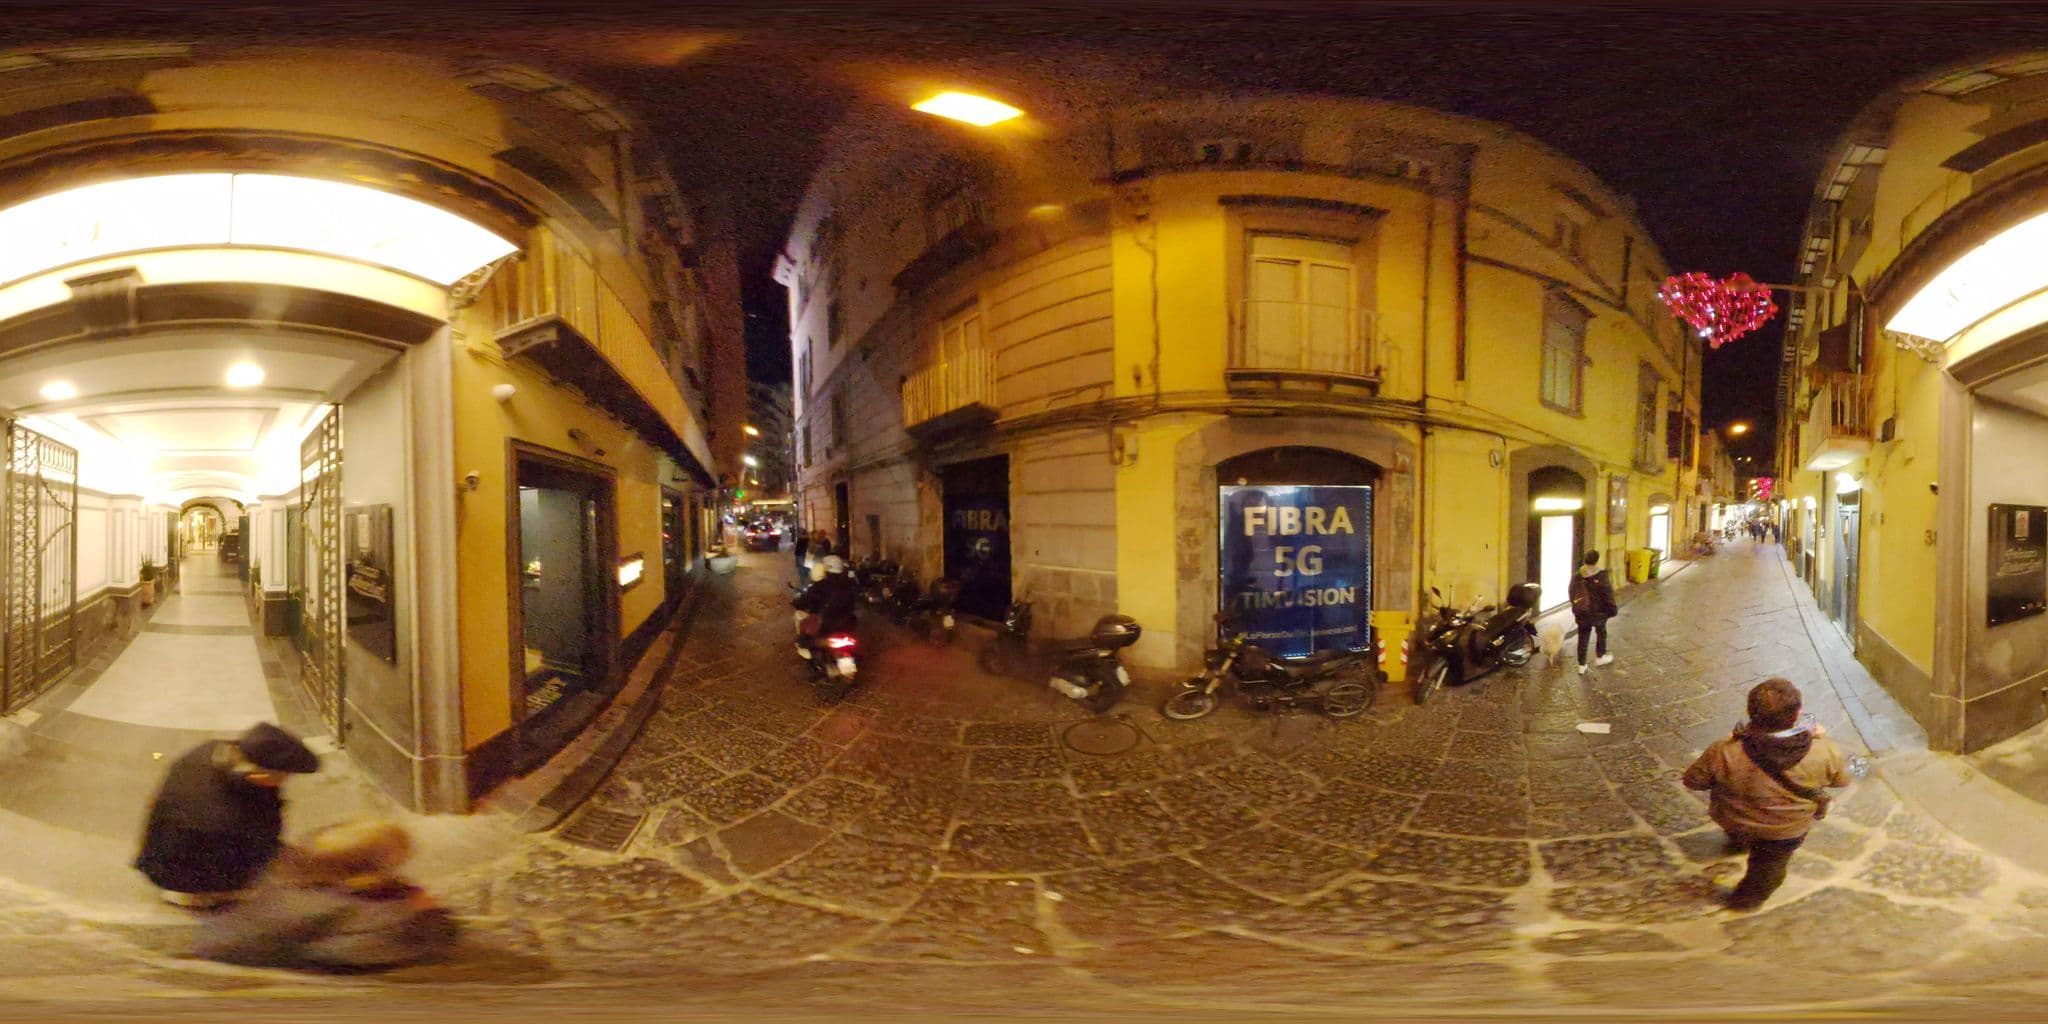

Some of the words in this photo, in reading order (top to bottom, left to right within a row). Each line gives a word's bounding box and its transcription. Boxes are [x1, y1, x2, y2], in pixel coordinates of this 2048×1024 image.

[953, 510, 1006, 531] FIBRA
[1244, 506, 1354, 536] FIBRA
[1274, 545, 1323, 577] 5G
[1241, 588, 1355, 609] TIMSION
